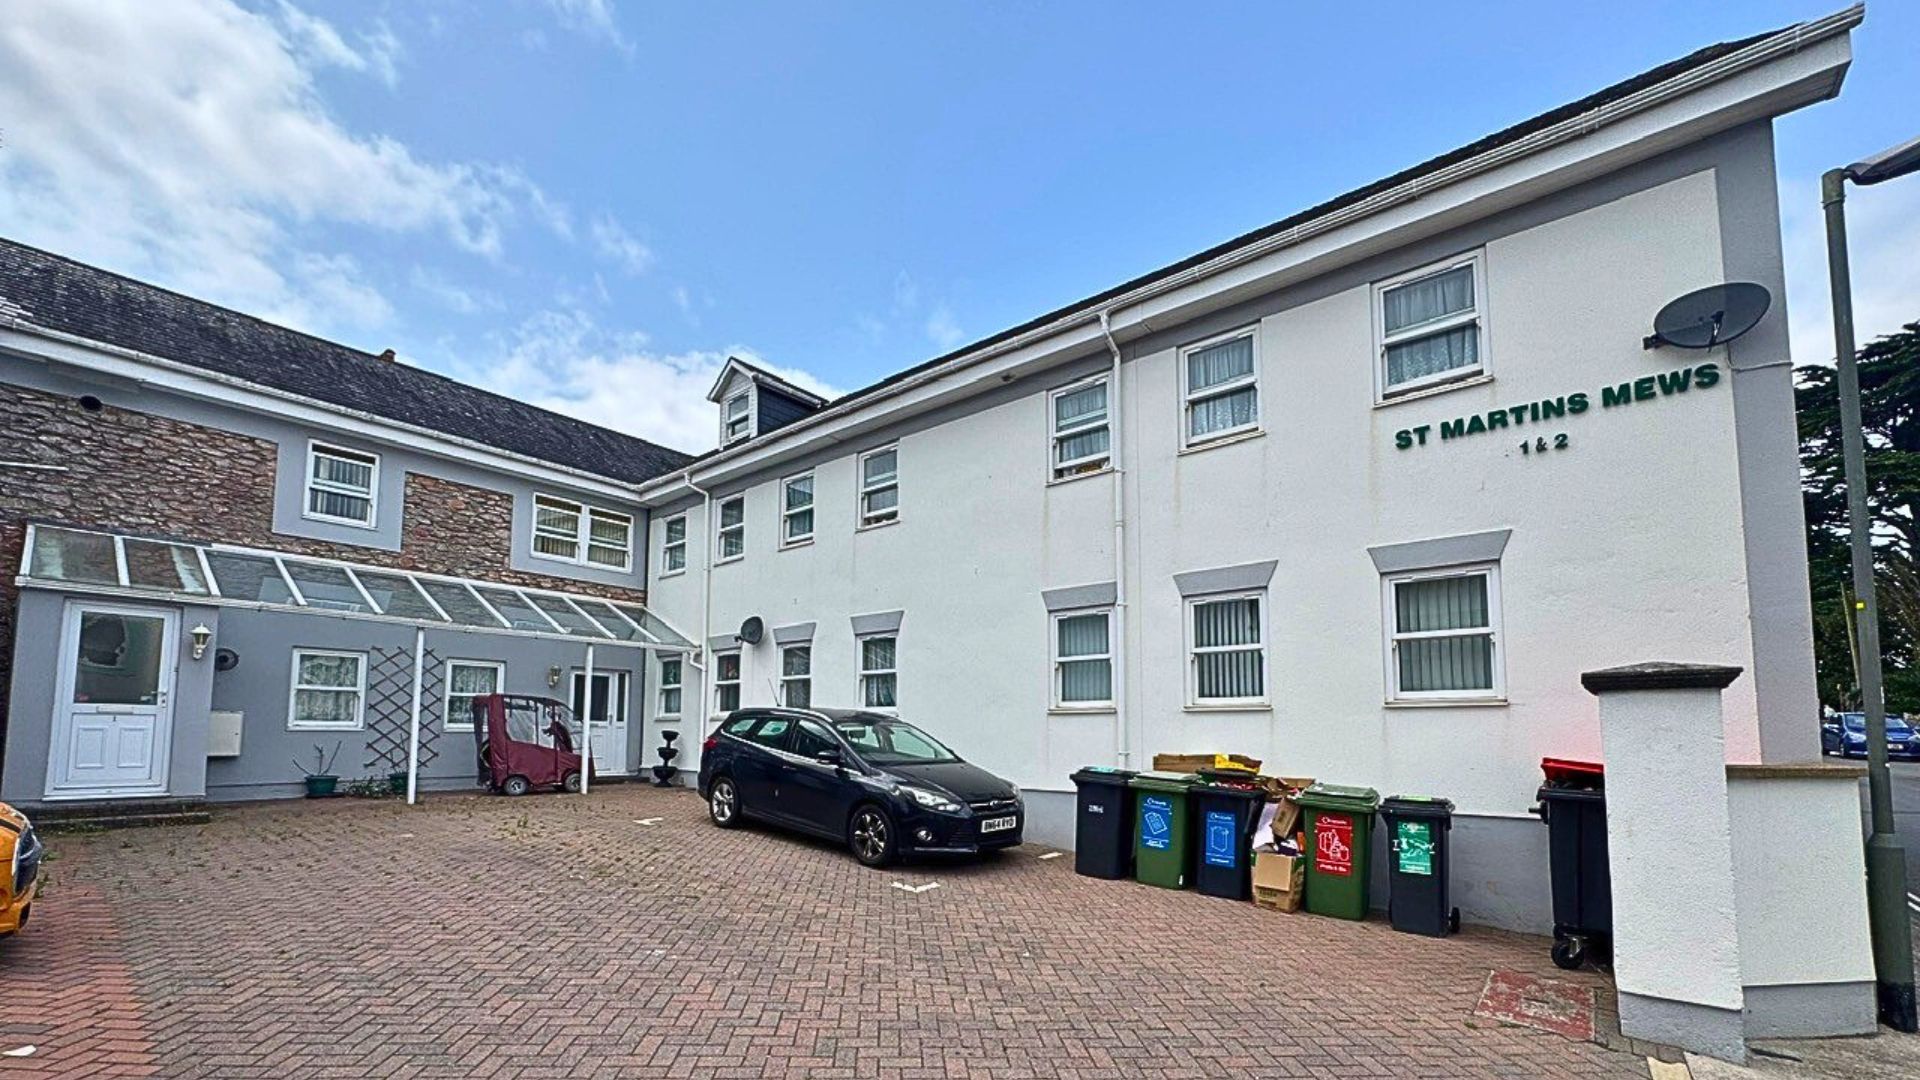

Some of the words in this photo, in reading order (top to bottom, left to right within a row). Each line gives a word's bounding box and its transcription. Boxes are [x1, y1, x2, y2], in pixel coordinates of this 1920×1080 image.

[1395, 424, 1431, 450] ST
[1440, 393, 1589, 441] MARTINS
[1601, 363, 1720, 408] MEWS
[1519, 440, 1529, 455] 1
[1535, 436, 1547, 453] &
[1554, 433, 1568, 450] 2
